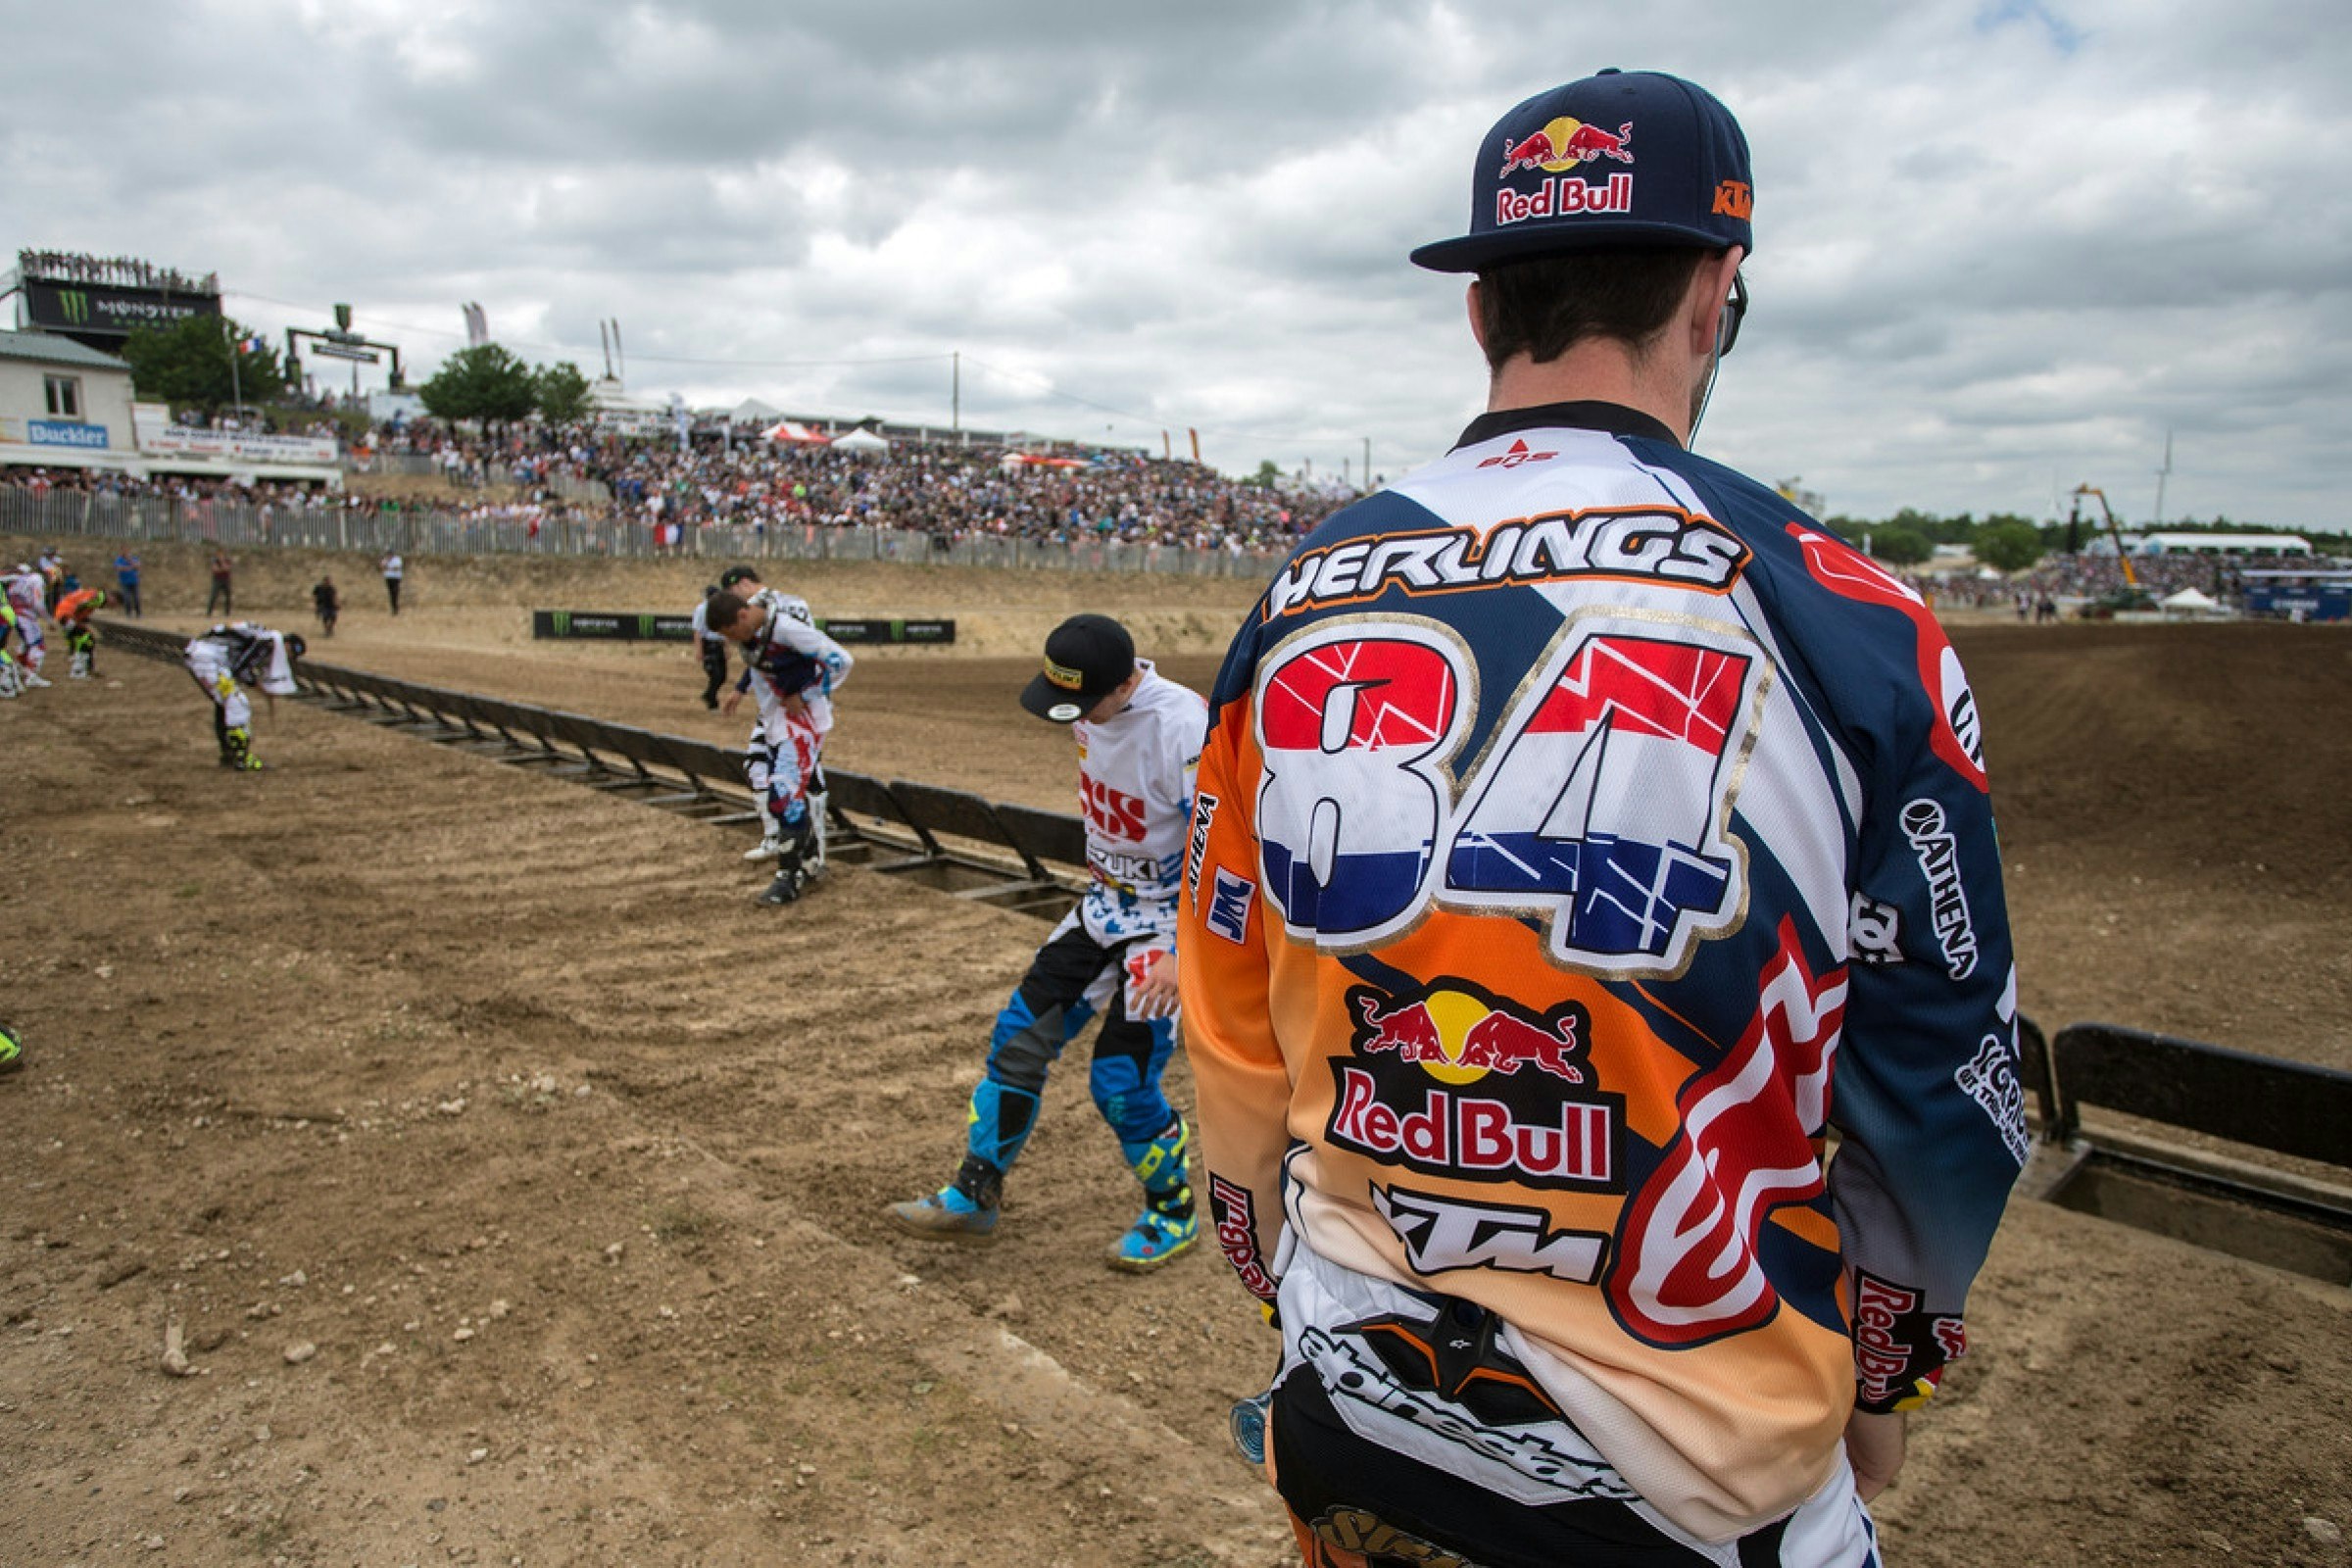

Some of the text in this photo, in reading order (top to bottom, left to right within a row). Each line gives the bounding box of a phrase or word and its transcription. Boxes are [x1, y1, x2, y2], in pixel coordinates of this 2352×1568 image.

[1496, 172, 1634, 226] Red Bull
[1265, 508, 1750, 621] HERLINGS
[1254, 608, 1776, 978] 84
[1914, 833, 1978, 980] ATHENA
[1334, 1066, 1612, 1182] Red Bull
[1214, 1178, 1251, 1248] Bull
[1370, 1181, 1609, 1284] KTM
[1858, 1277, 1916, 1355] Red
